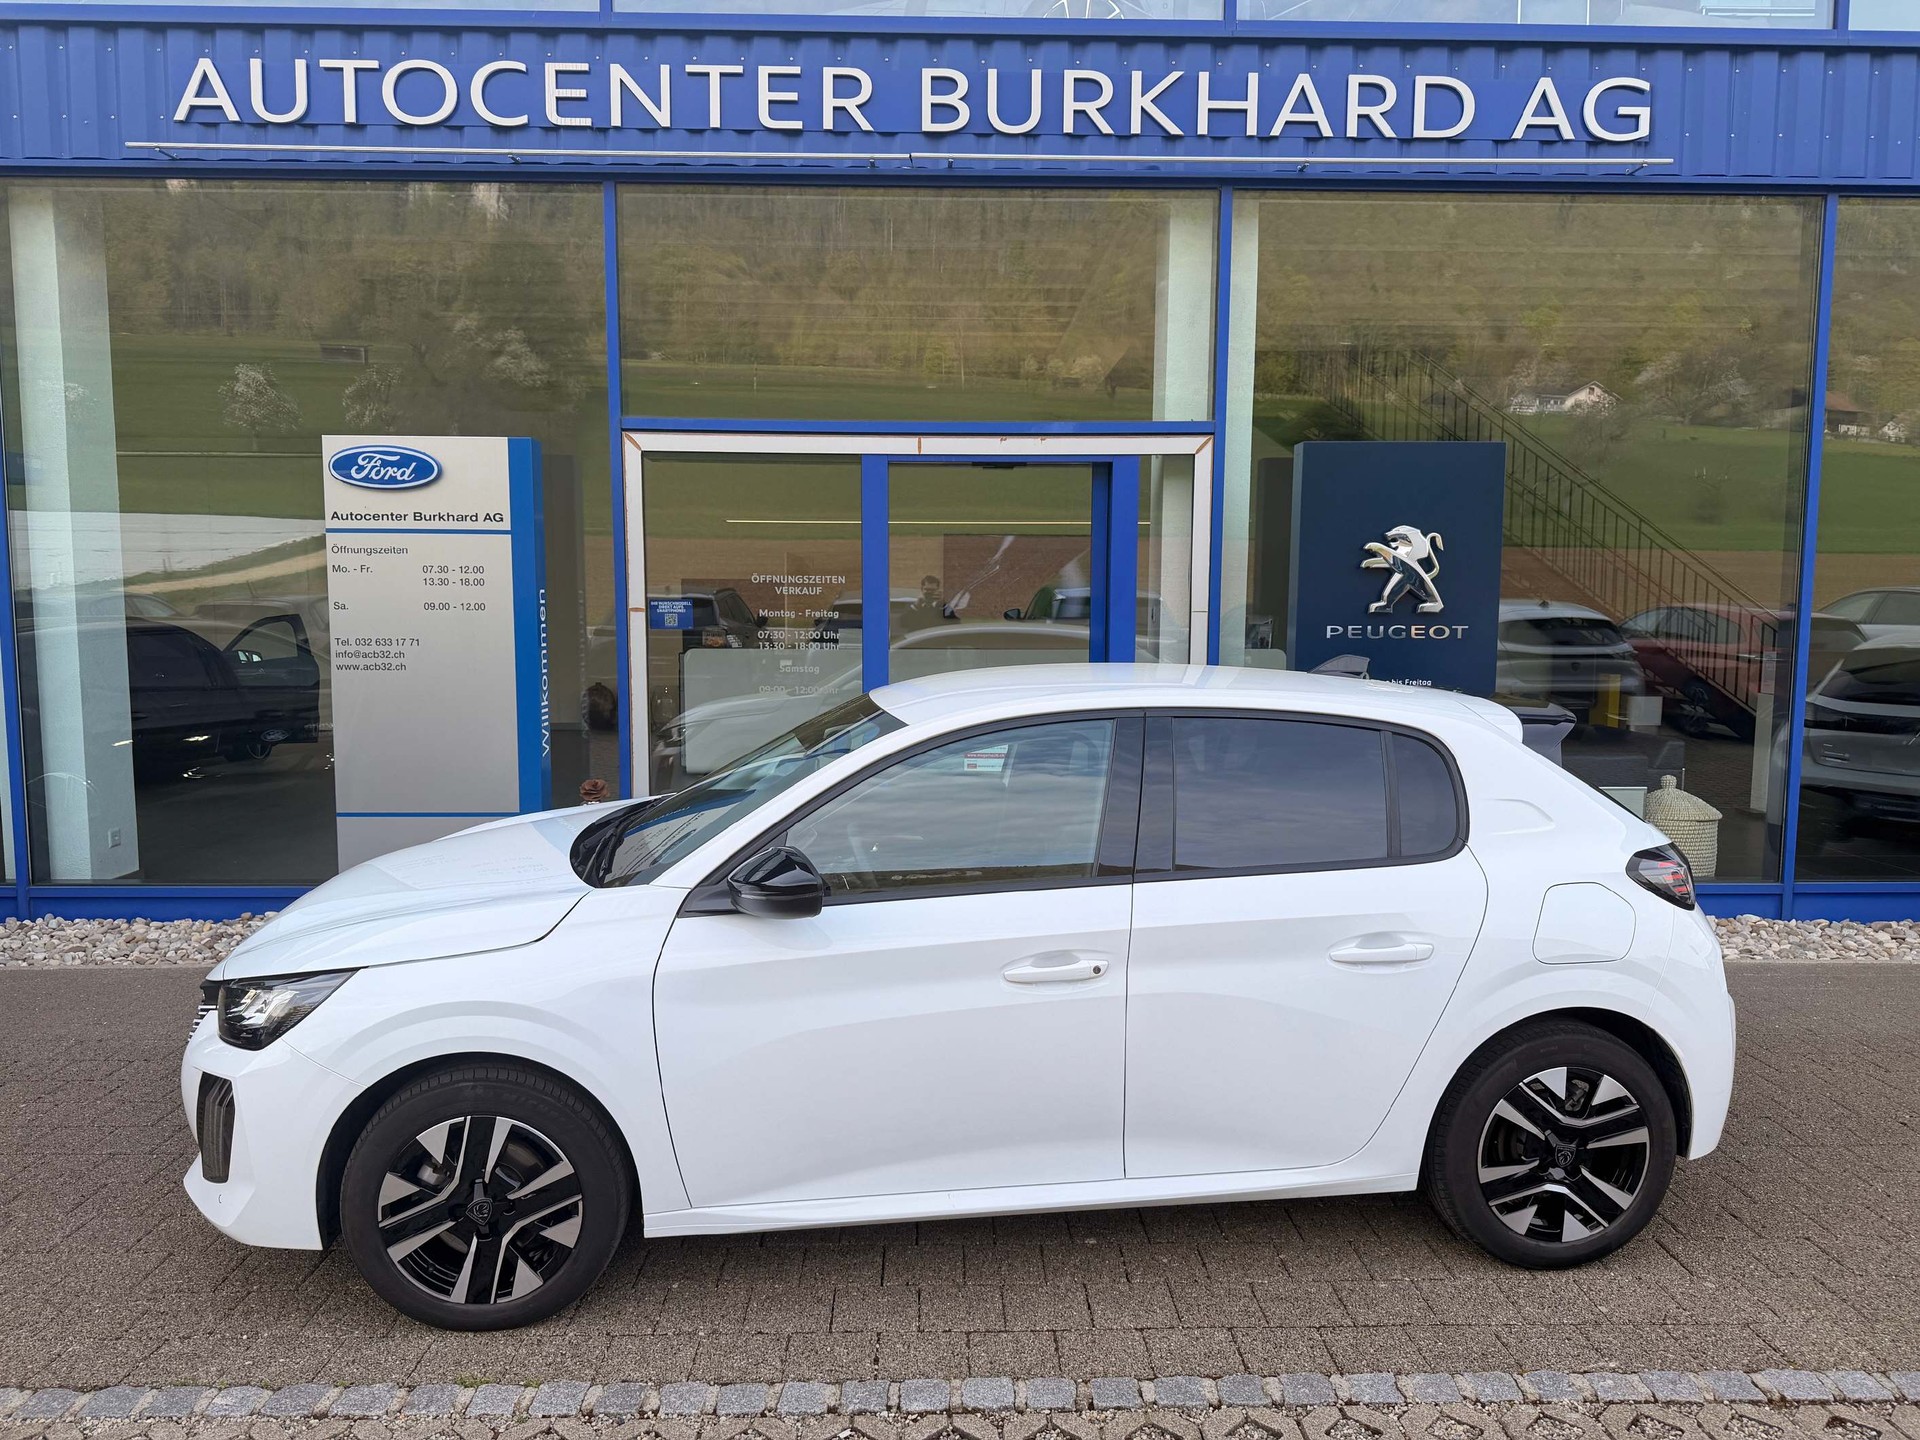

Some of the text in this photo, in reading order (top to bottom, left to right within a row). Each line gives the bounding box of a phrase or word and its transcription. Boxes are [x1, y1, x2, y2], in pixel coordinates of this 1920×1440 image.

[173, 58, 1652, 142] AUTOCENTER BURKHARD AG
[351, 453, 416, 480] Ford
[331, 511, 504, 523] Autocenter Burkhard AG
[331, 544, 409, 556] Öffnungszeiten
[332, 564, 350, 574] Mo.
[360, 565, 373, 574] Fr.
[422, 565, 449, 574] 07.30
[458, 565, 485, 575] 12.00
[423, 578, 450, 587] 13.30
[459, 578, 485, 587] 18.00
[751, 573, 846, 584] ÖFFNUNGSZEITEN
[774, 586, 823, 595] VERKAUF
[333, 601, 349, 611] Sa.
[423, 602, 451, 611] 09.00
[460, 602, 486, 611] 12.00
[759, 609, 796, 619] Montag
[805, 609, 839, 619] Freitag
[757, 630, 785, 639] 07:30
[795, 631, 821, 639] 12:00
[823, 630, 840, 639] Uhr
[1326, 625, 1469, 639] PEUGEOT
[334, 638, 420, 647] Tel. 032 633 17 71
[758, 642, 785, 650] 13:30
[795, 642, 821, 650] 18:00
[823, 642, 840, 650] Uhr
[335, 650, 405, 660] info@acb32.ch
[336, 663, 407, 672] www.acb32.ch
[780, 665, 820, 675] Samstag
[539, 589, 550, 758] Willkommen
[759, 685, 785, 694] 09:00
[795, 686, 820, 694] 12:00
